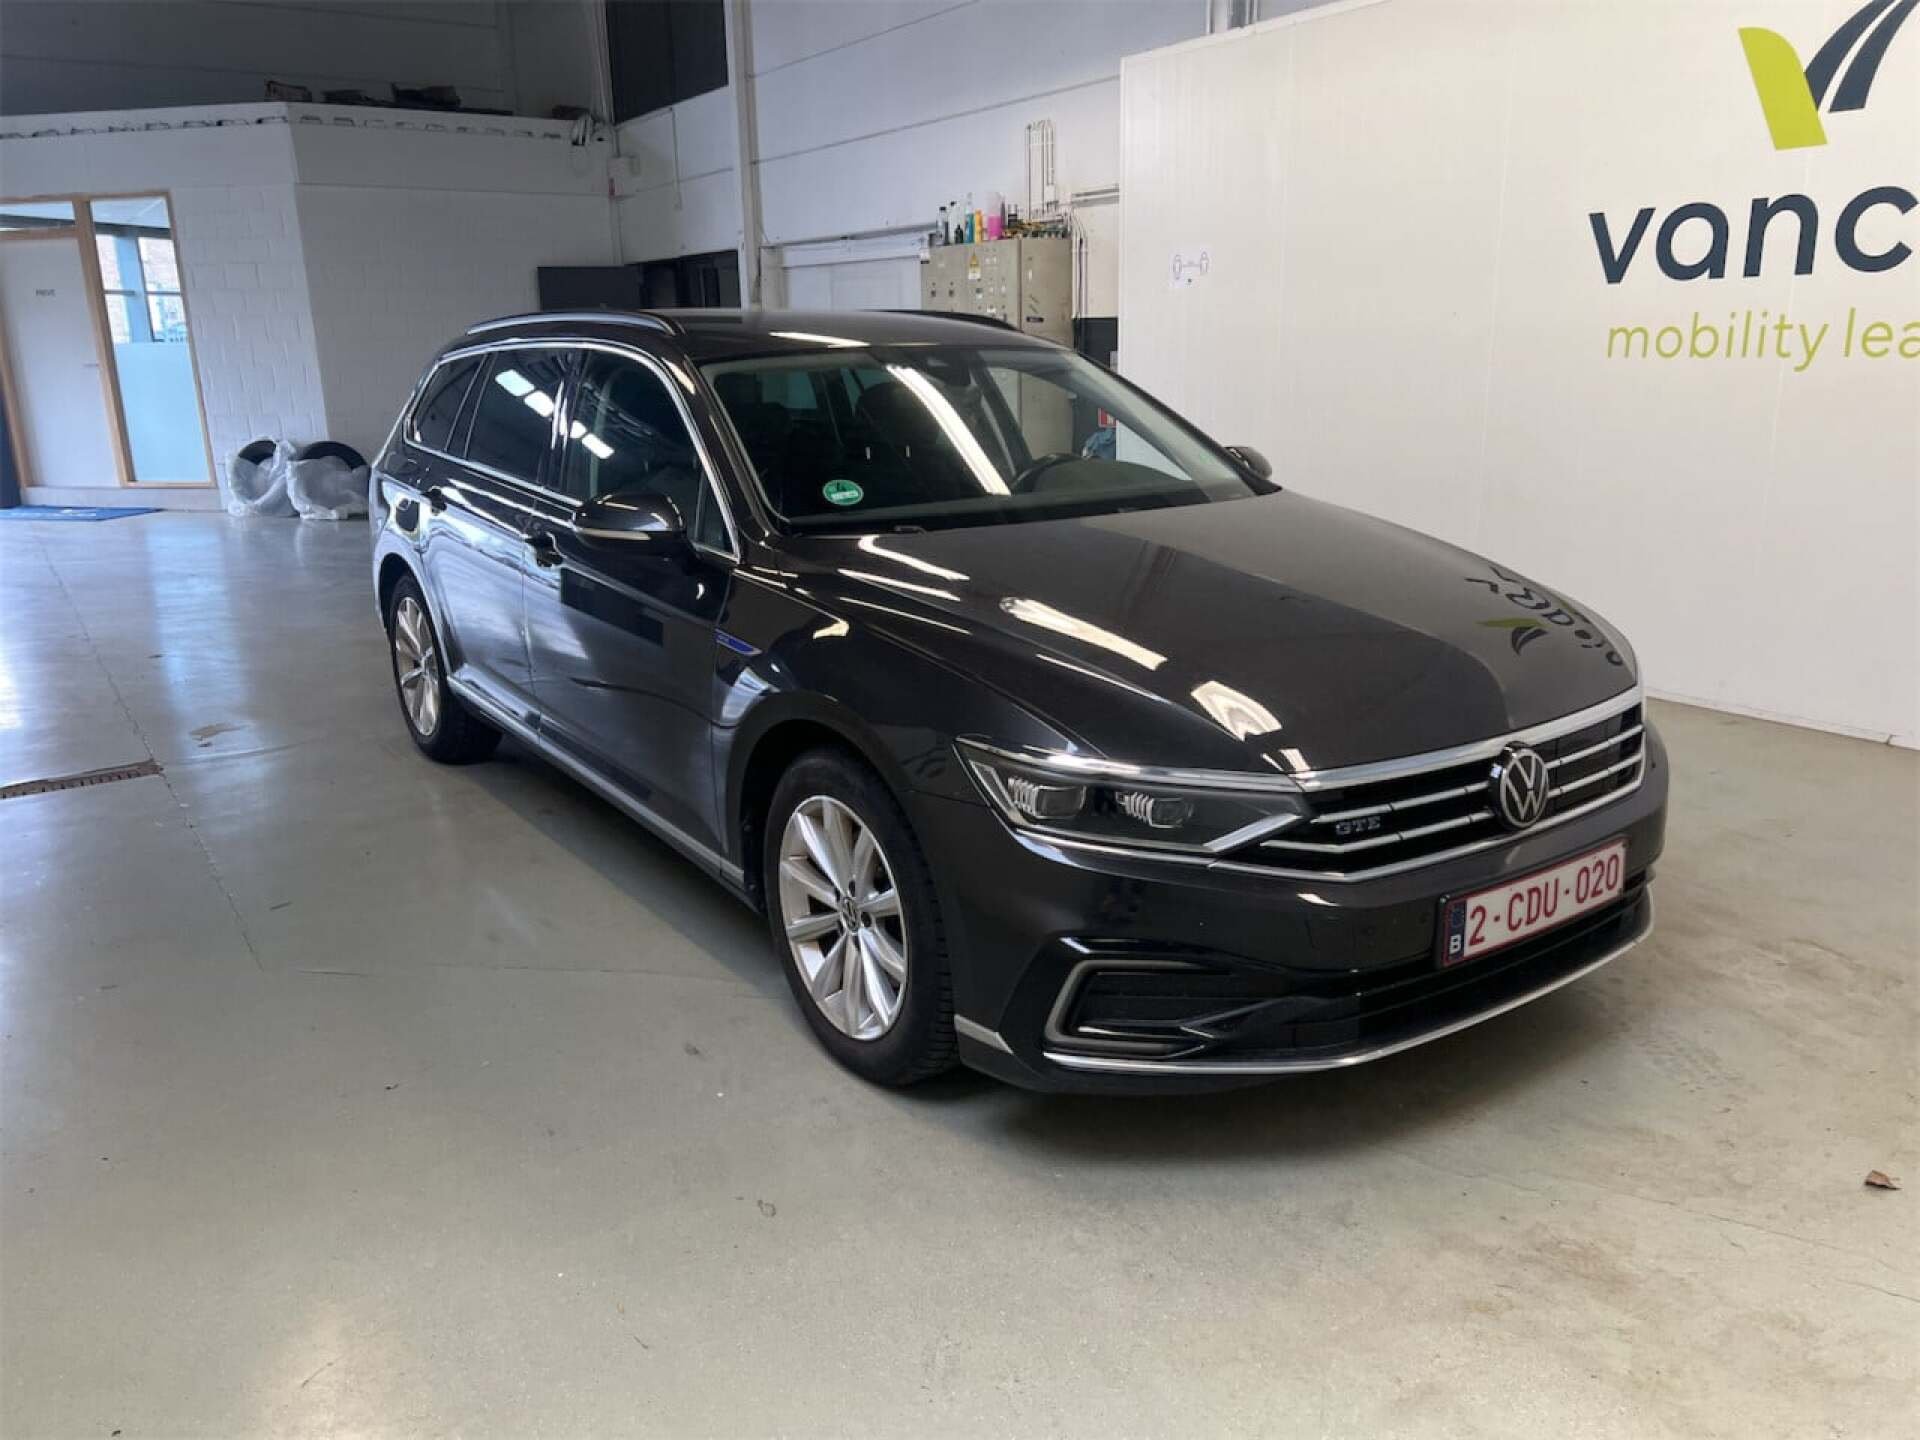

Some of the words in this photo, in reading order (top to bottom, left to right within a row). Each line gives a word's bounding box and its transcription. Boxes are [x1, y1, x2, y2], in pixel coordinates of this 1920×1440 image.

[1588, 185, 1920, 284] vanc
[1607, 309, 1829, 372] mobility
[1335, 815, 1381, 835] GTE
[1449, 935, 1462, 955] B
